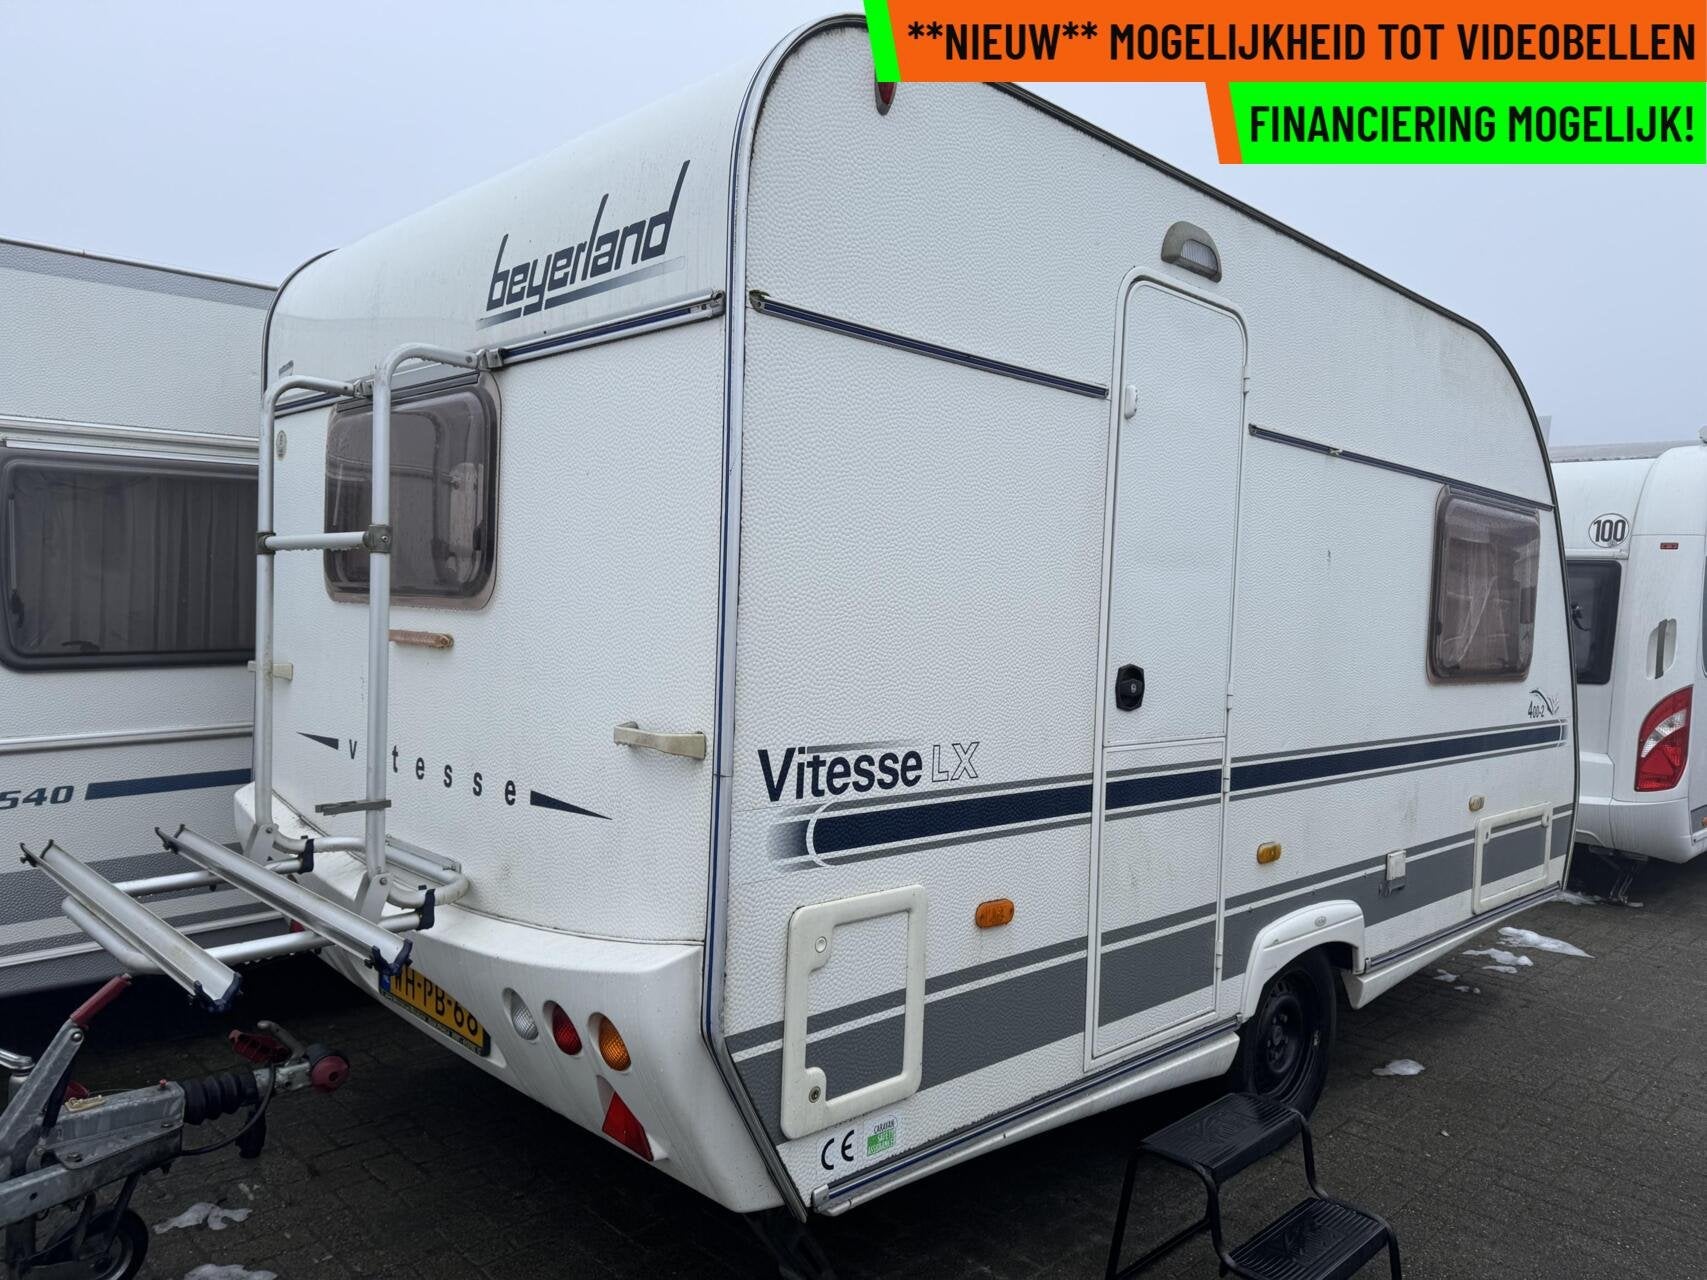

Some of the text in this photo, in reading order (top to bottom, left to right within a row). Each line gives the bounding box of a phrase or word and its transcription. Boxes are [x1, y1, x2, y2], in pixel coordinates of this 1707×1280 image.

[485, 159, 691, 317] beyerland
[1593, 519, 1627, 543] 100
[0, 785, 75, 810] 540
[348, 737, 517, 807] vtesse
[757, 741, 981, 803] Vitesse LX
[820, 1129, 855, 1171] CE
